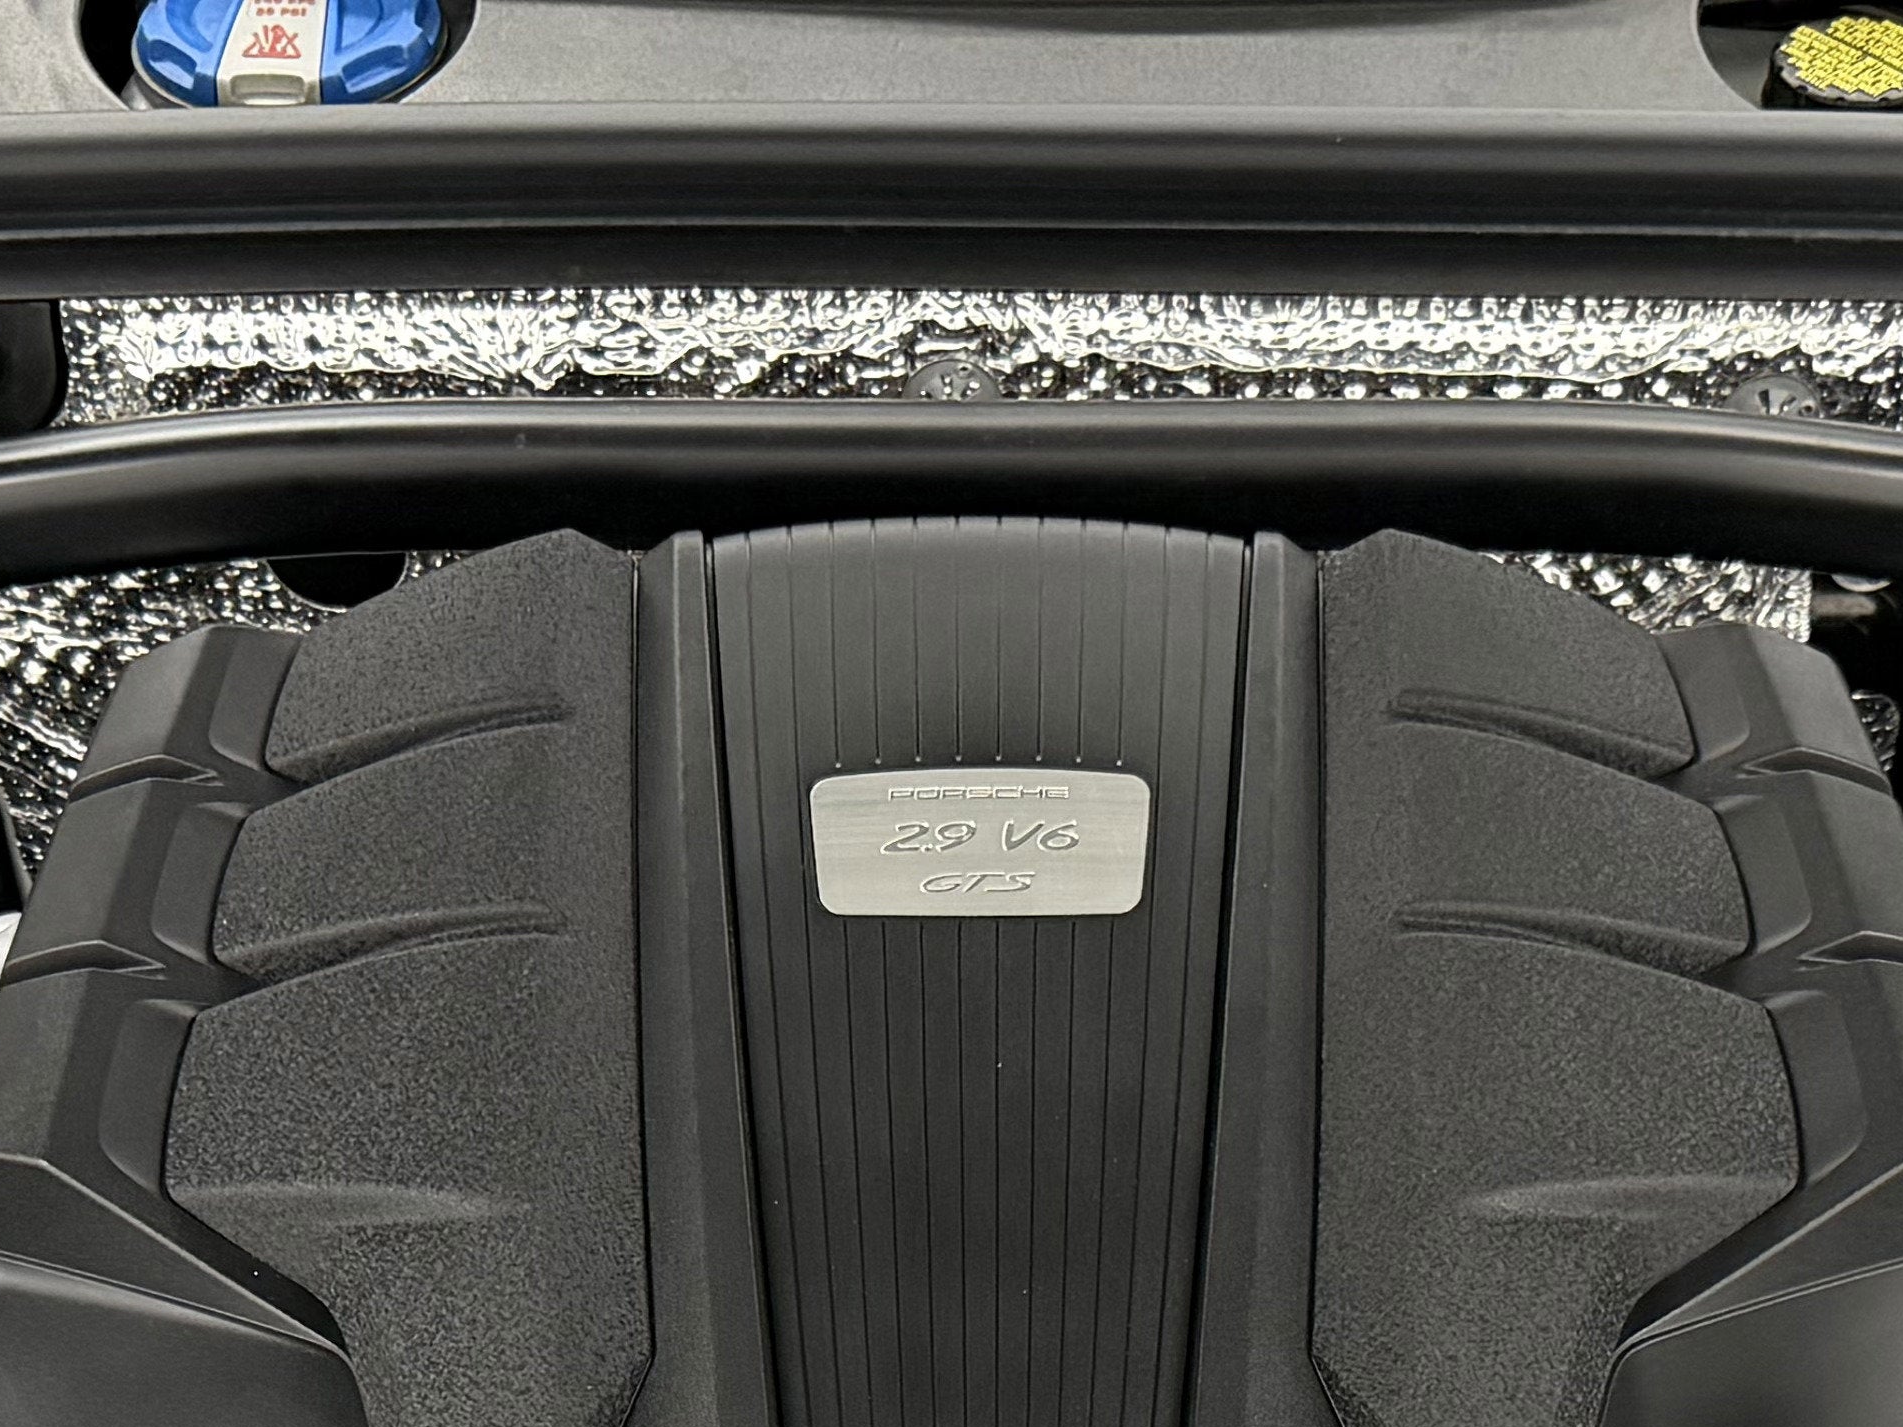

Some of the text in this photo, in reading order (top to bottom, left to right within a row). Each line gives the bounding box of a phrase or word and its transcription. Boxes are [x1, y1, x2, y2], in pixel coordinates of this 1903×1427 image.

[888, 785, 1070, 801] PORSCHE
[880, 819, 1081, 855] 2.9 V6
[919, 870, 1037, 894] GTS
